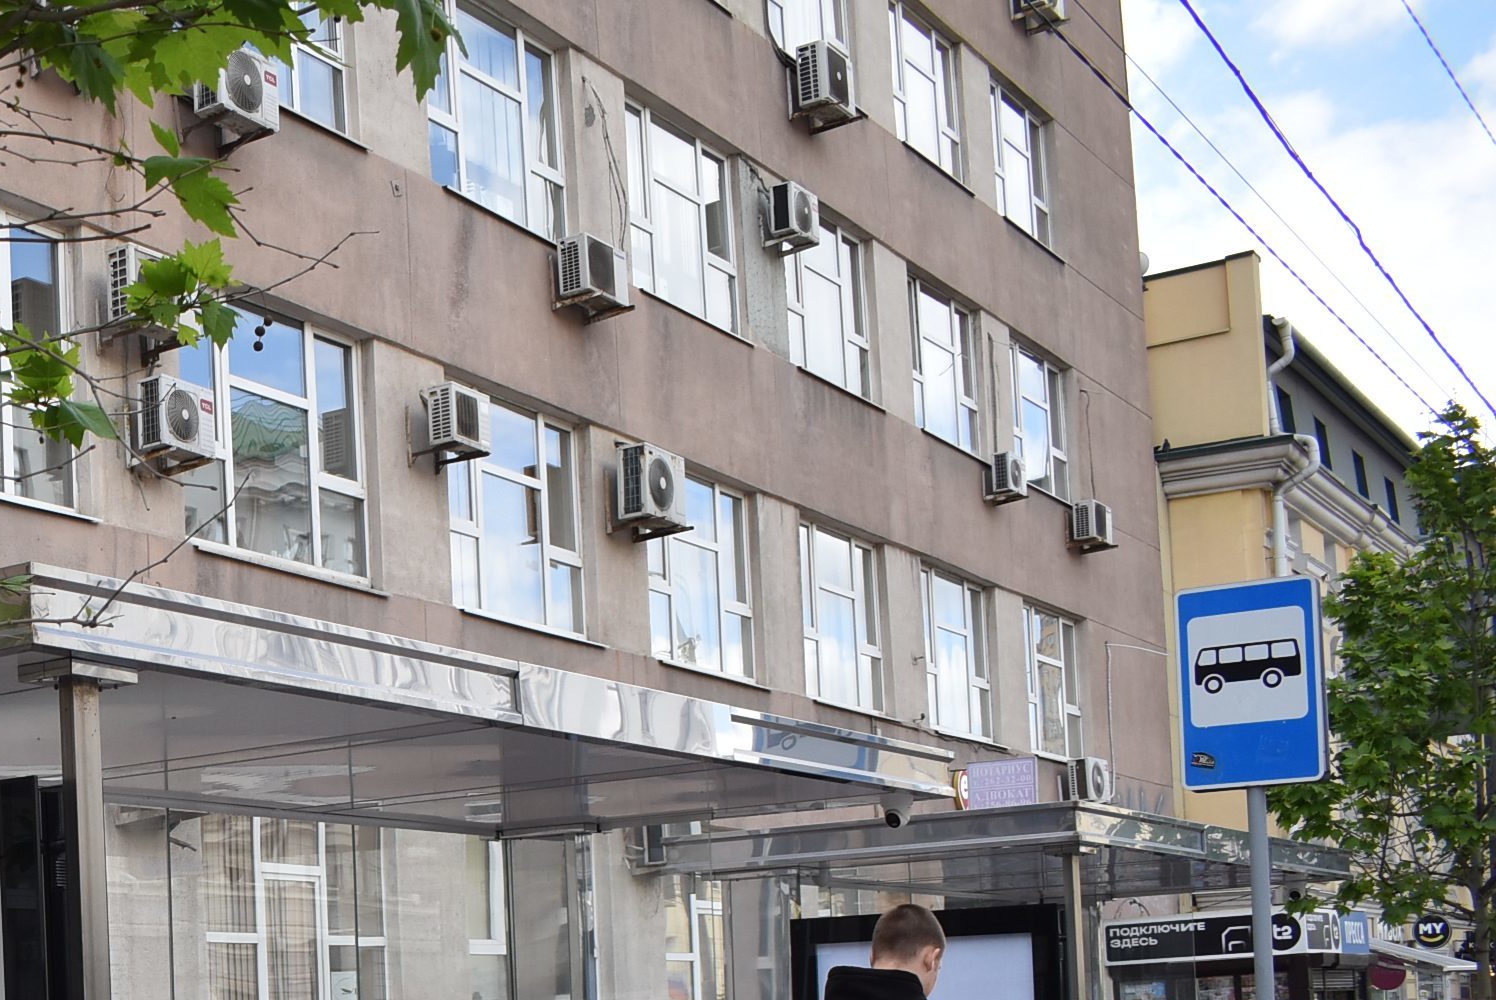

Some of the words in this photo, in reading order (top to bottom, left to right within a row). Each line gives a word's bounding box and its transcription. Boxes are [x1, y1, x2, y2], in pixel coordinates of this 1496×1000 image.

[972, 763, 1030, 777] НОТАРИУС
[975, 788, 1029, 800] АДВОКАТ
[1109, 922, 1206, 937] ПОДКЛЮЧИТЕ
[1273, 924, 1292, 940] t2
[1345, 921, 1365, 944] ПРЕССА
[1419, 923, 1444, 934] MY
[1110, 937, 1158, 948] ЗДЕСЬ
